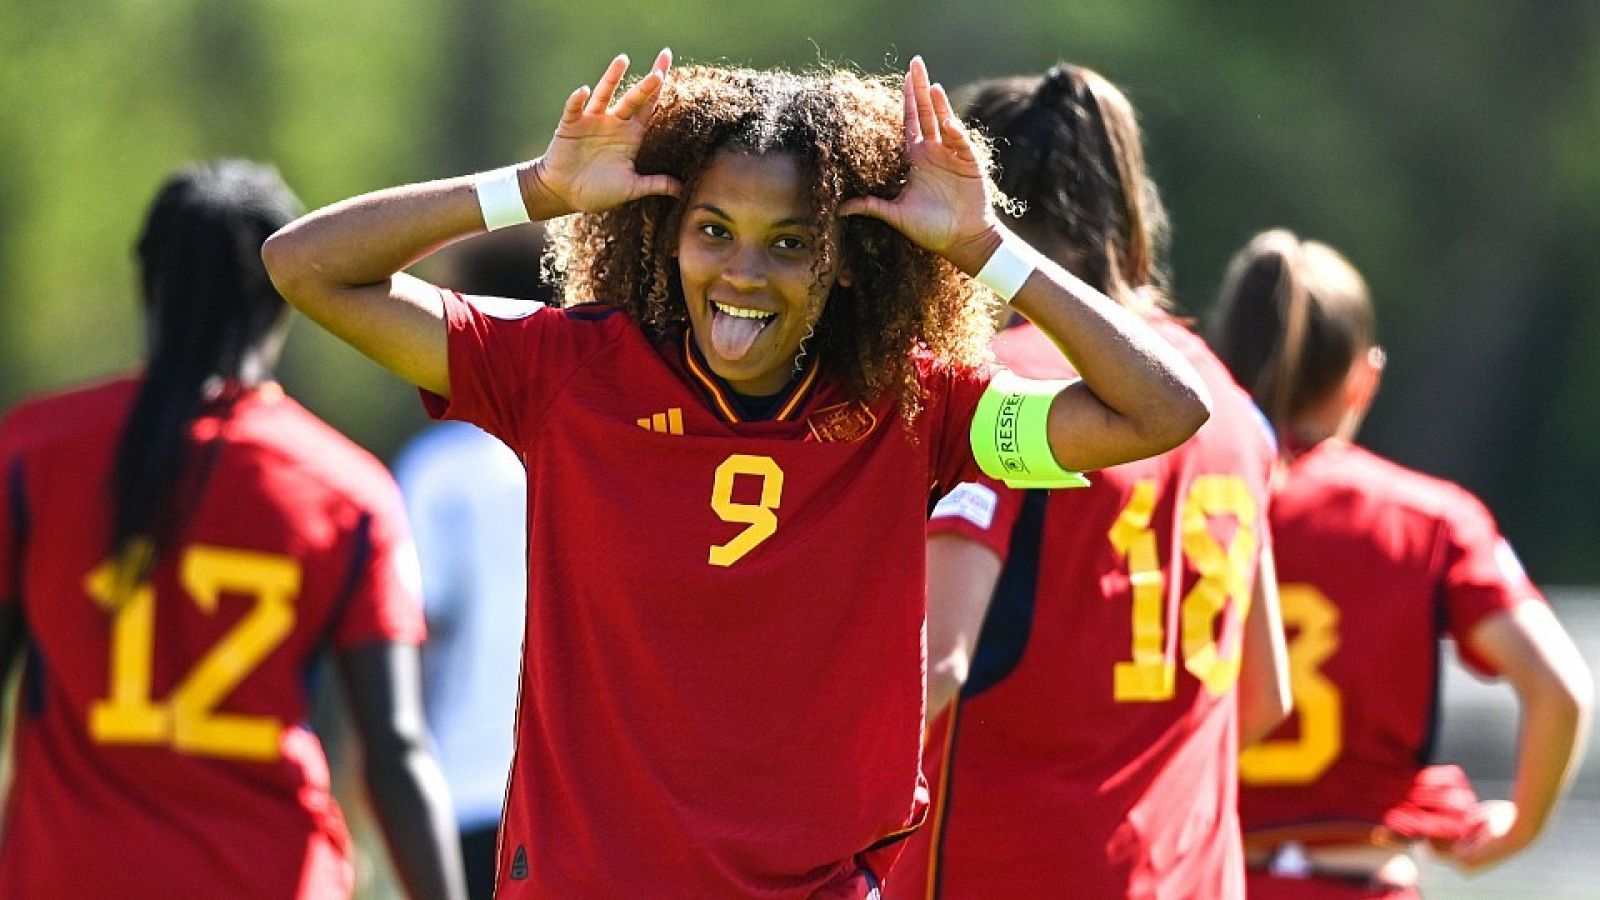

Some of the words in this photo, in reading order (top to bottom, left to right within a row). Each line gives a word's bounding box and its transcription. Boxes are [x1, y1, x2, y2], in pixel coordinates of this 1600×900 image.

[708, 454, 784, 567] 9
[1109, 475, 1255, 701] 18
[86, 542, 301, 760] 12
